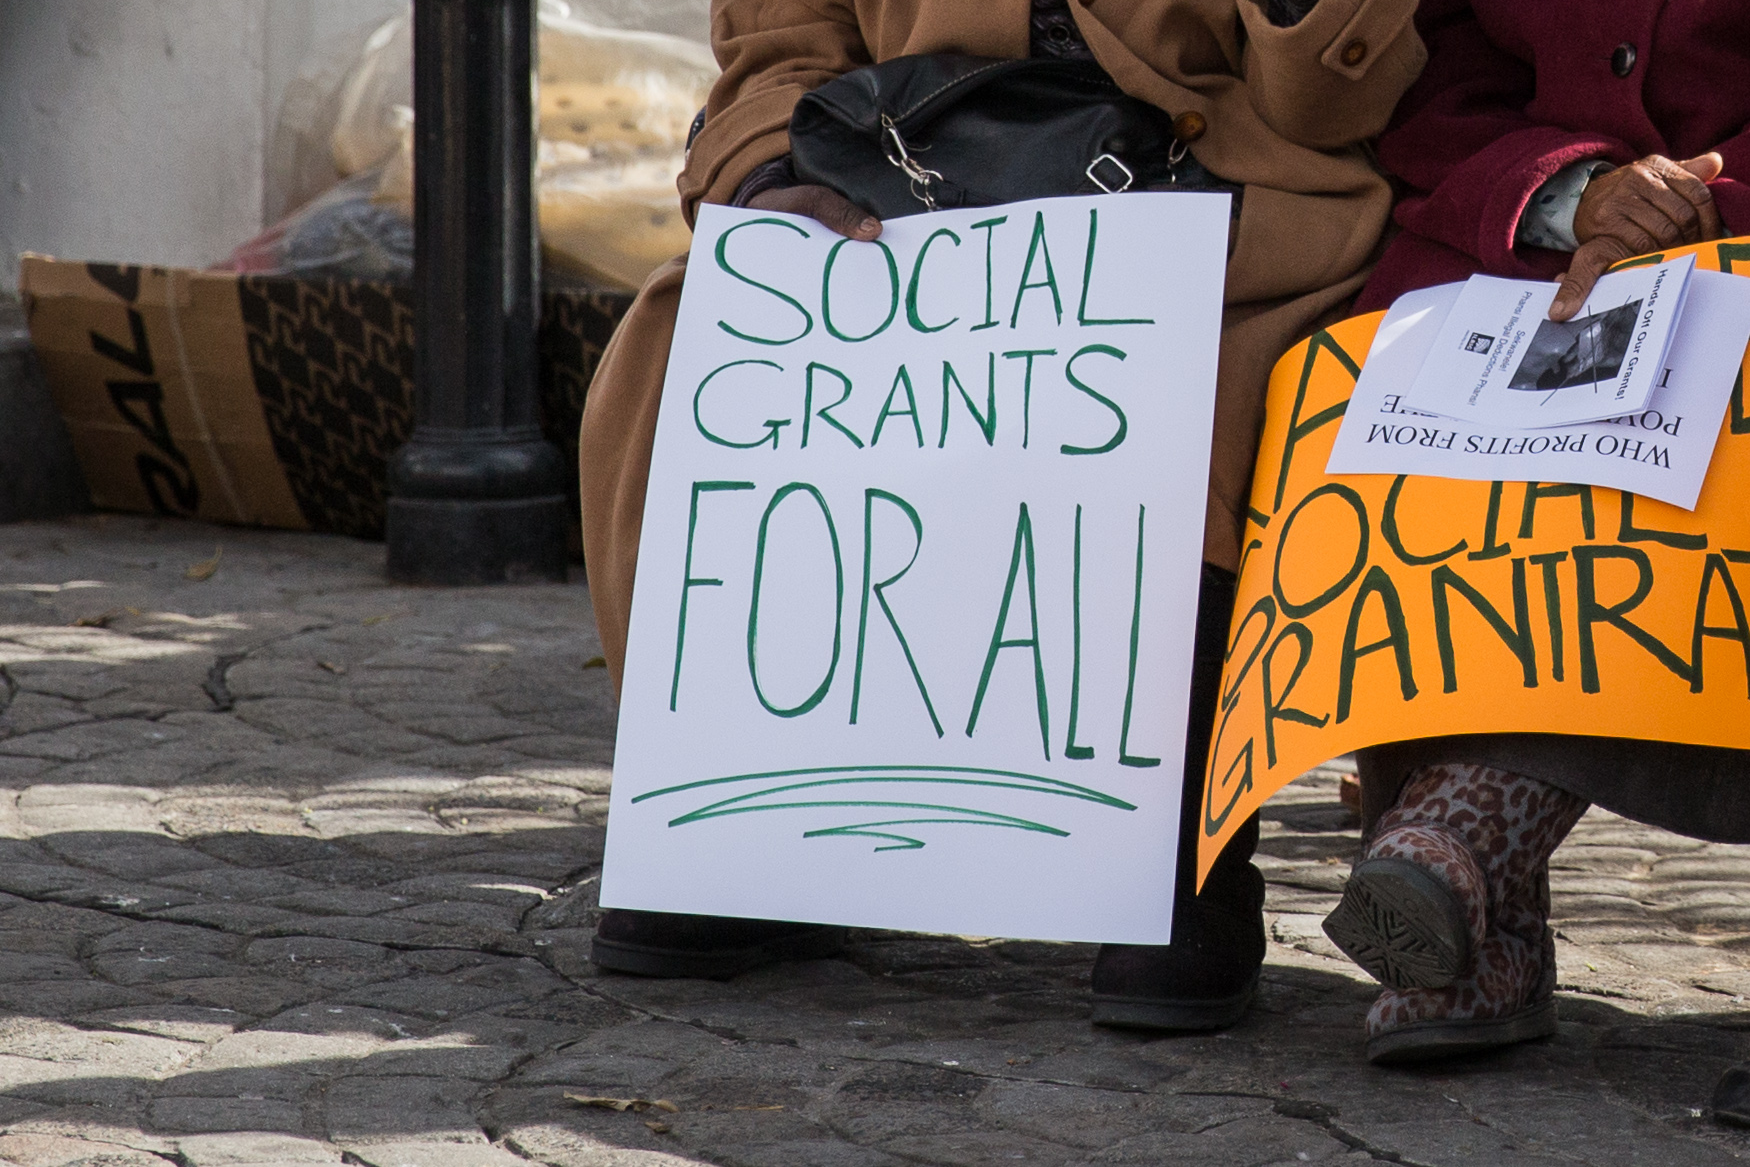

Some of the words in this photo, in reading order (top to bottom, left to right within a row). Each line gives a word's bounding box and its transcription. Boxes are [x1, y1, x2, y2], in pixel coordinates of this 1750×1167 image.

[714, 209, 1155, 345] SOCIAL
[1647, 268, 1669, 308] Hands
[1641, 309, 1654, 329] Off
[1633, 331, 1647, 354] Our
[1614, 356, 1639, 401] Grants!
[693, 345, 1128, 455] GRANTS
[1366, 423, 1460, 451] FROM
[1464, 433, 1590, 455] PROFITS
[1595, 434, 1672, 470] WHO
[669, 480, 944, 739] FOR
[966, 502, 1161, 768] ALL
